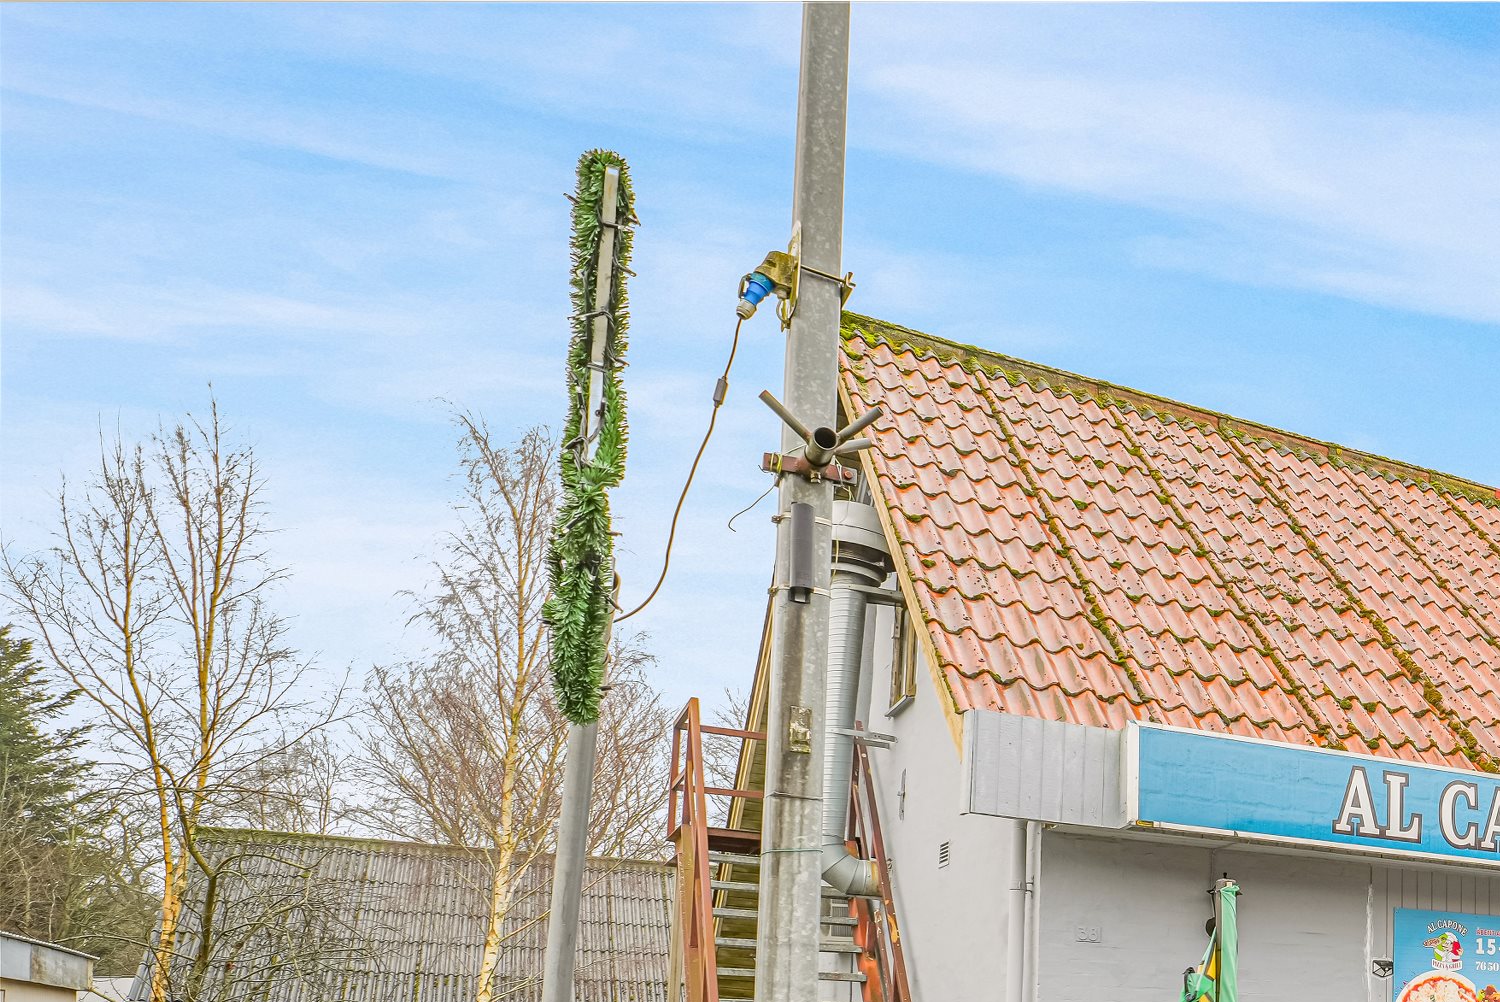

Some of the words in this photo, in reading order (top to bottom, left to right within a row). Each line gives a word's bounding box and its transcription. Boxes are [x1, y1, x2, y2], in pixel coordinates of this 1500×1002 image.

[1333, 765, 1423, 843] AL
[1427, 922, 1438, 934] AL
[1437, 919, 1469, 937] CAPONE
[1475, 961, 1487, 971] 76
[1487, 962, 1500, 971] 50
